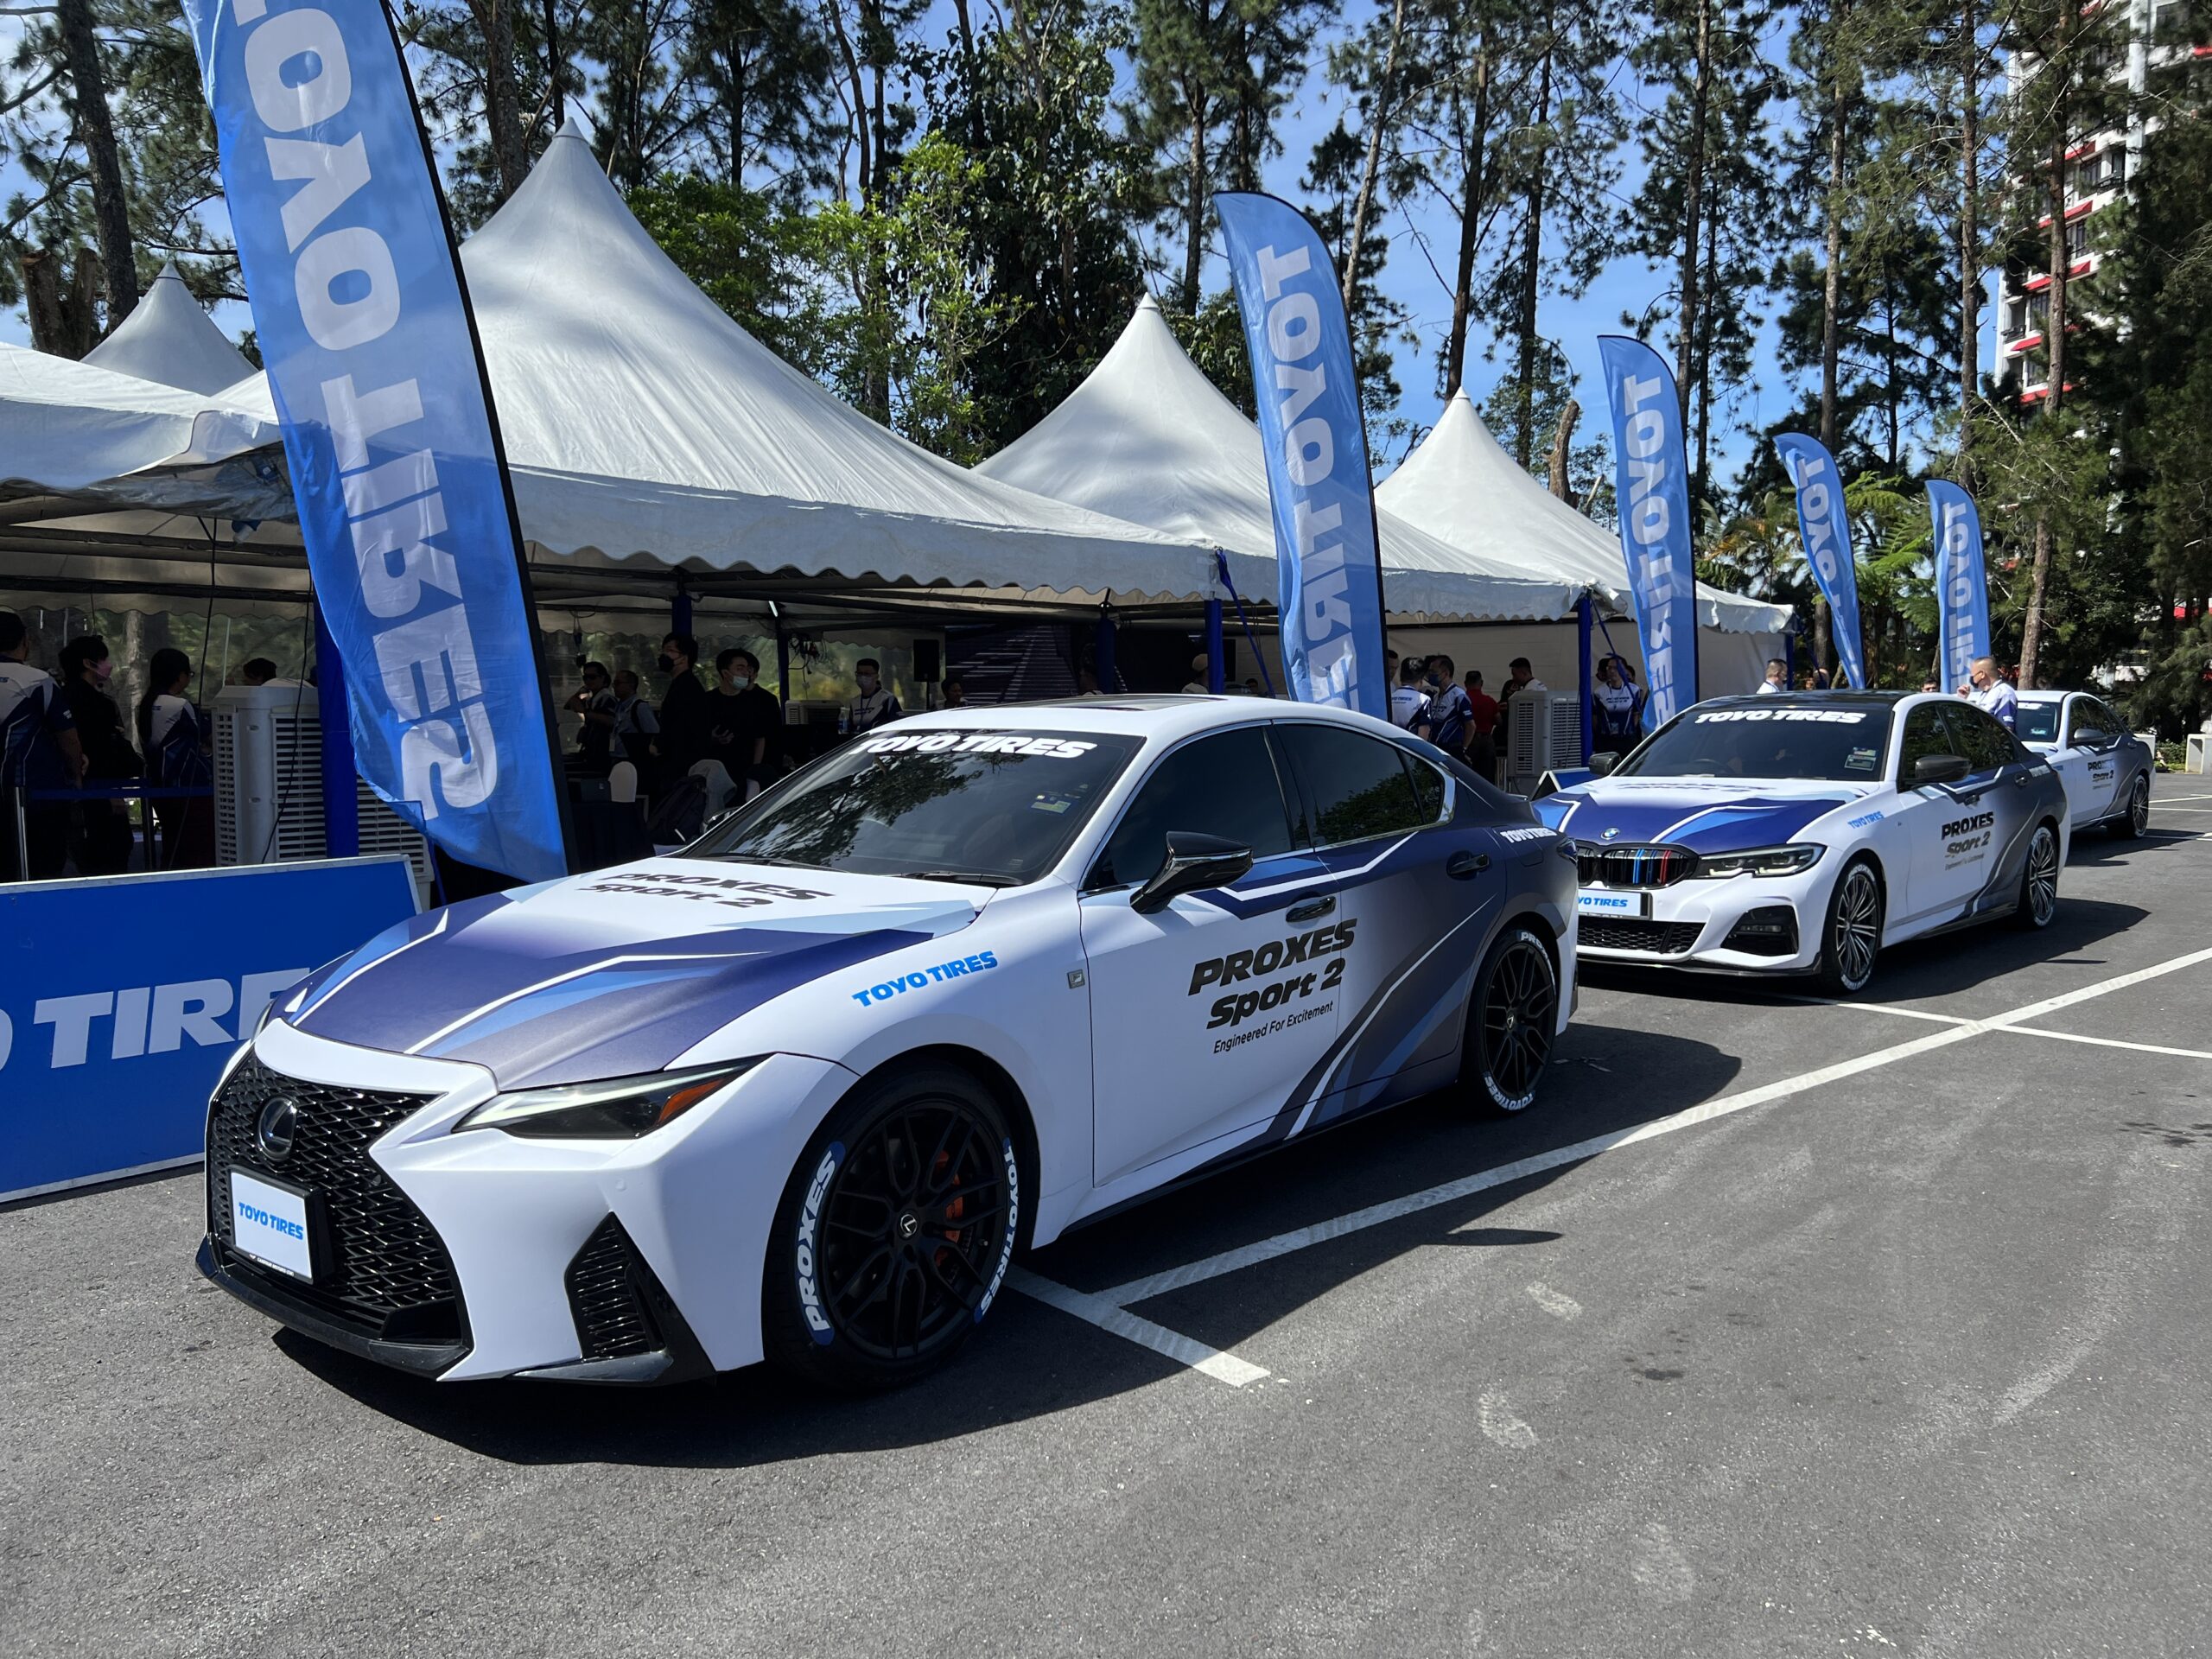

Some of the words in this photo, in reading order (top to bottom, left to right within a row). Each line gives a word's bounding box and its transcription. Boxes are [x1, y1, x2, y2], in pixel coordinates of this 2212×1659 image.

[1694, 710, 1772, 724] TOYO
[1771, 709, 1866, 724] TIRES
[849, 734, 962, 755] TOYO
[951, 735, 1098, 759] TIRES
[1941, 810, 1994, 841] PROXES
[1981, 830, 1991, 847] 2
[599, 874, 836, 900] PROXES
[712, 897, 774, 908] 2
[1593, 897, 1628, 907] TIRES
[1188, 918, 1357, 996] PROXES
[851, 973, 929, 1007] TOYO
[925, 950, 999, 982] TIRES
[1206, 972, 1317, 1029] Sport
[1320, 957, 1346, 991] 2
[1213, 1022, 1268, 1054] Engineered
[1268, 1018, 1286, 1034] For
[1287, 1000, 1334, 1027] Excitement
[1003, 1145, 1019, 1228] TOYO
[238, 1202, 269, 1226] TOYO
[269, 1214, 304, 1241] TIRES
[797, 1150, 836, 1332] PROXES
[980, 1224, 1016, 1316] TIRES
